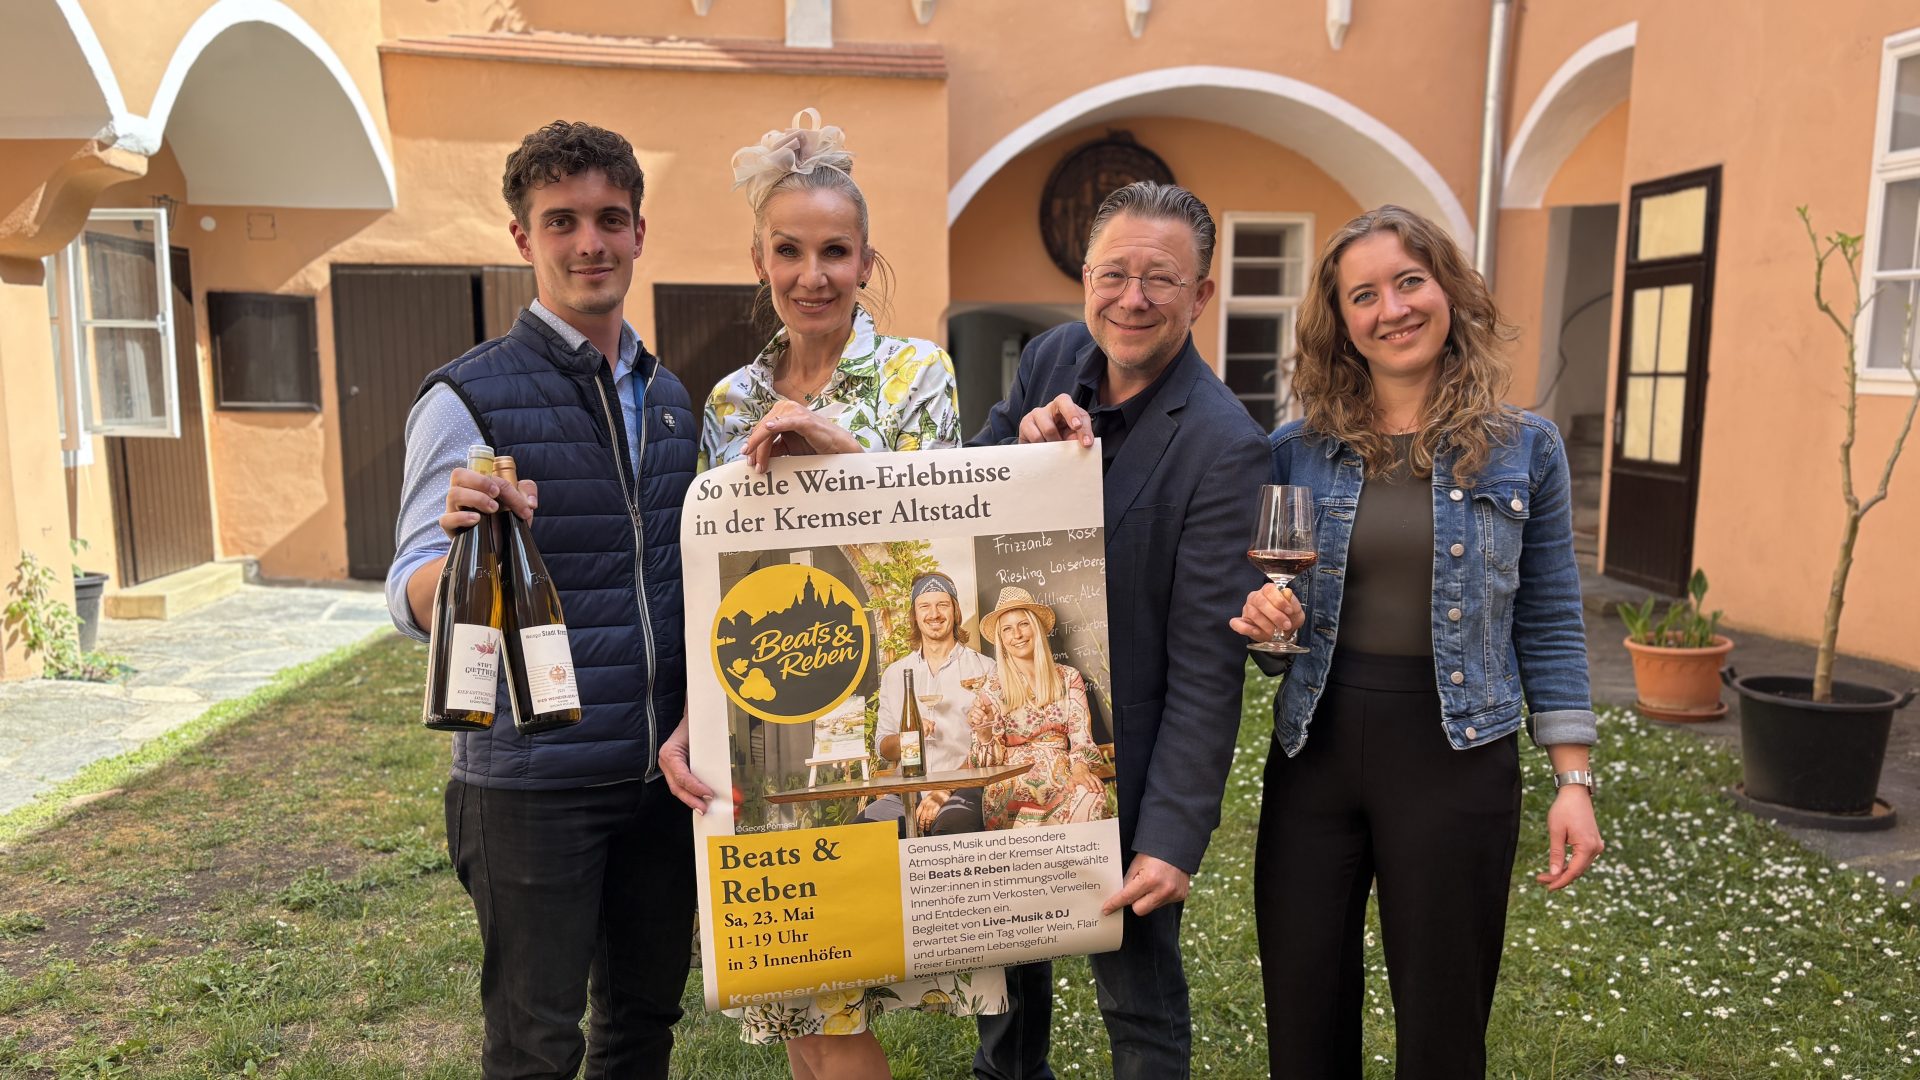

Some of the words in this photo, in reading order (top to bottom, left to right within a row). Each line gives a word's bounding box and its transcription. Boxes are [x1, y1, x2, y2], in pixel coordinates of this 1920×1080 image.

[697, 479, 722, 500] So
[730, 471, 789, 497] viele
[794, 462, 1011, 493] Wein-Erlebnisse
[695, 515, 718, 535] in
[725, 509, 765, 533] der
[774, 507, 882, 531] Kremser
[890, 494, 991, 523] Altstadt
[993, 532, 1053, 555] Frizzante
[996, 566, 1045, 586] Riesling
[1050, 556, 1106, 574] Loiserberg
[750, 619, 837, 662] Beats
[832, 624, 856, 647] &
[777, 645, 859, 680] Reben
[719, 845, 800, 870] Beats
[812, 838, 841, 862] &
[908, 843, 951, 854] Genuss,
[953, 838, 983, 850] Musik
[985, 836, 1006, 847] und
[1008, 832, 1066, 845] besondere
[908, 854, 975, 868] Atmosphäre
[977, 852, 986, 861] in
[989, 851, 1007, 861] der
[1009, 847, 1053, 859] Kremser
[1055, 841, 1100, 854] Altstadt:
[909, 871, 926, 882] Bei
[928, 869, 962, 880] Beats
[963, 867, 972, 876] &
[974, 864, 1010, 875] Reben
[1012, 861, 1041, 871] laden
[1044, 854, 1109, 869] ausgewählte
[721, 876, 817, 904] Reben
[910, 881, 979, 895] Winzer:innen
[981, 879, 991, 888] in
[993, 870, 1077, 887] stimmungsvolle
[911, 895, 965, 908] Innenhöfe
[967, 893, 991, 903] zum
[993, 886, 1048, 900] Verkosten,
[1050, 881, 1100, 894] Verweilen
[724, 913, 748, 928] Sa,
[752, 911, 778, 925] 23.
[783, 907, 815, 922] Mai
[911, 911, 933, 921] und
[935, 907, 991, 919] Entdecken
[993, 904, 1012, 913] ein.
[912, 922, 959, 935] Begleitet
[961, 920, 980, 929] von
[983, 912, 1043, 926] Live-Musik
[1045, 911, 1053, 919] &
[1056, 909, 1070, 918] DJ
[728, 933, 772, 949] 11-19
[778, 929, 809, 945] Uhr
[912, 935, 958, 947] erwartet
[960, 932, 976, 941] Sie
[978, 931, 994, 940] ein
[996, 928, 1015, 939] Tag
[1016, 926, 1044, 936] voller
[1046, 922, 1075, 932] Wein,
[1077, 918, 1099, 928] Flair
[728, 959, 743, 971] in
[748, 956, 758, 970] 3
[764, 946, 852, 967] Innenhöfen
[913, 949, 934, 959] und
[937, 945, 985, 957] urbanem
[987, 936, 1059, 951] Lebensgefühl.
[914, 961, 943, 971] Freier
[945, 955, 984, 966] Eintritt!
[729, 985, 815, 1006] Kremser
[817, 974, 898, 993] Altstadt
